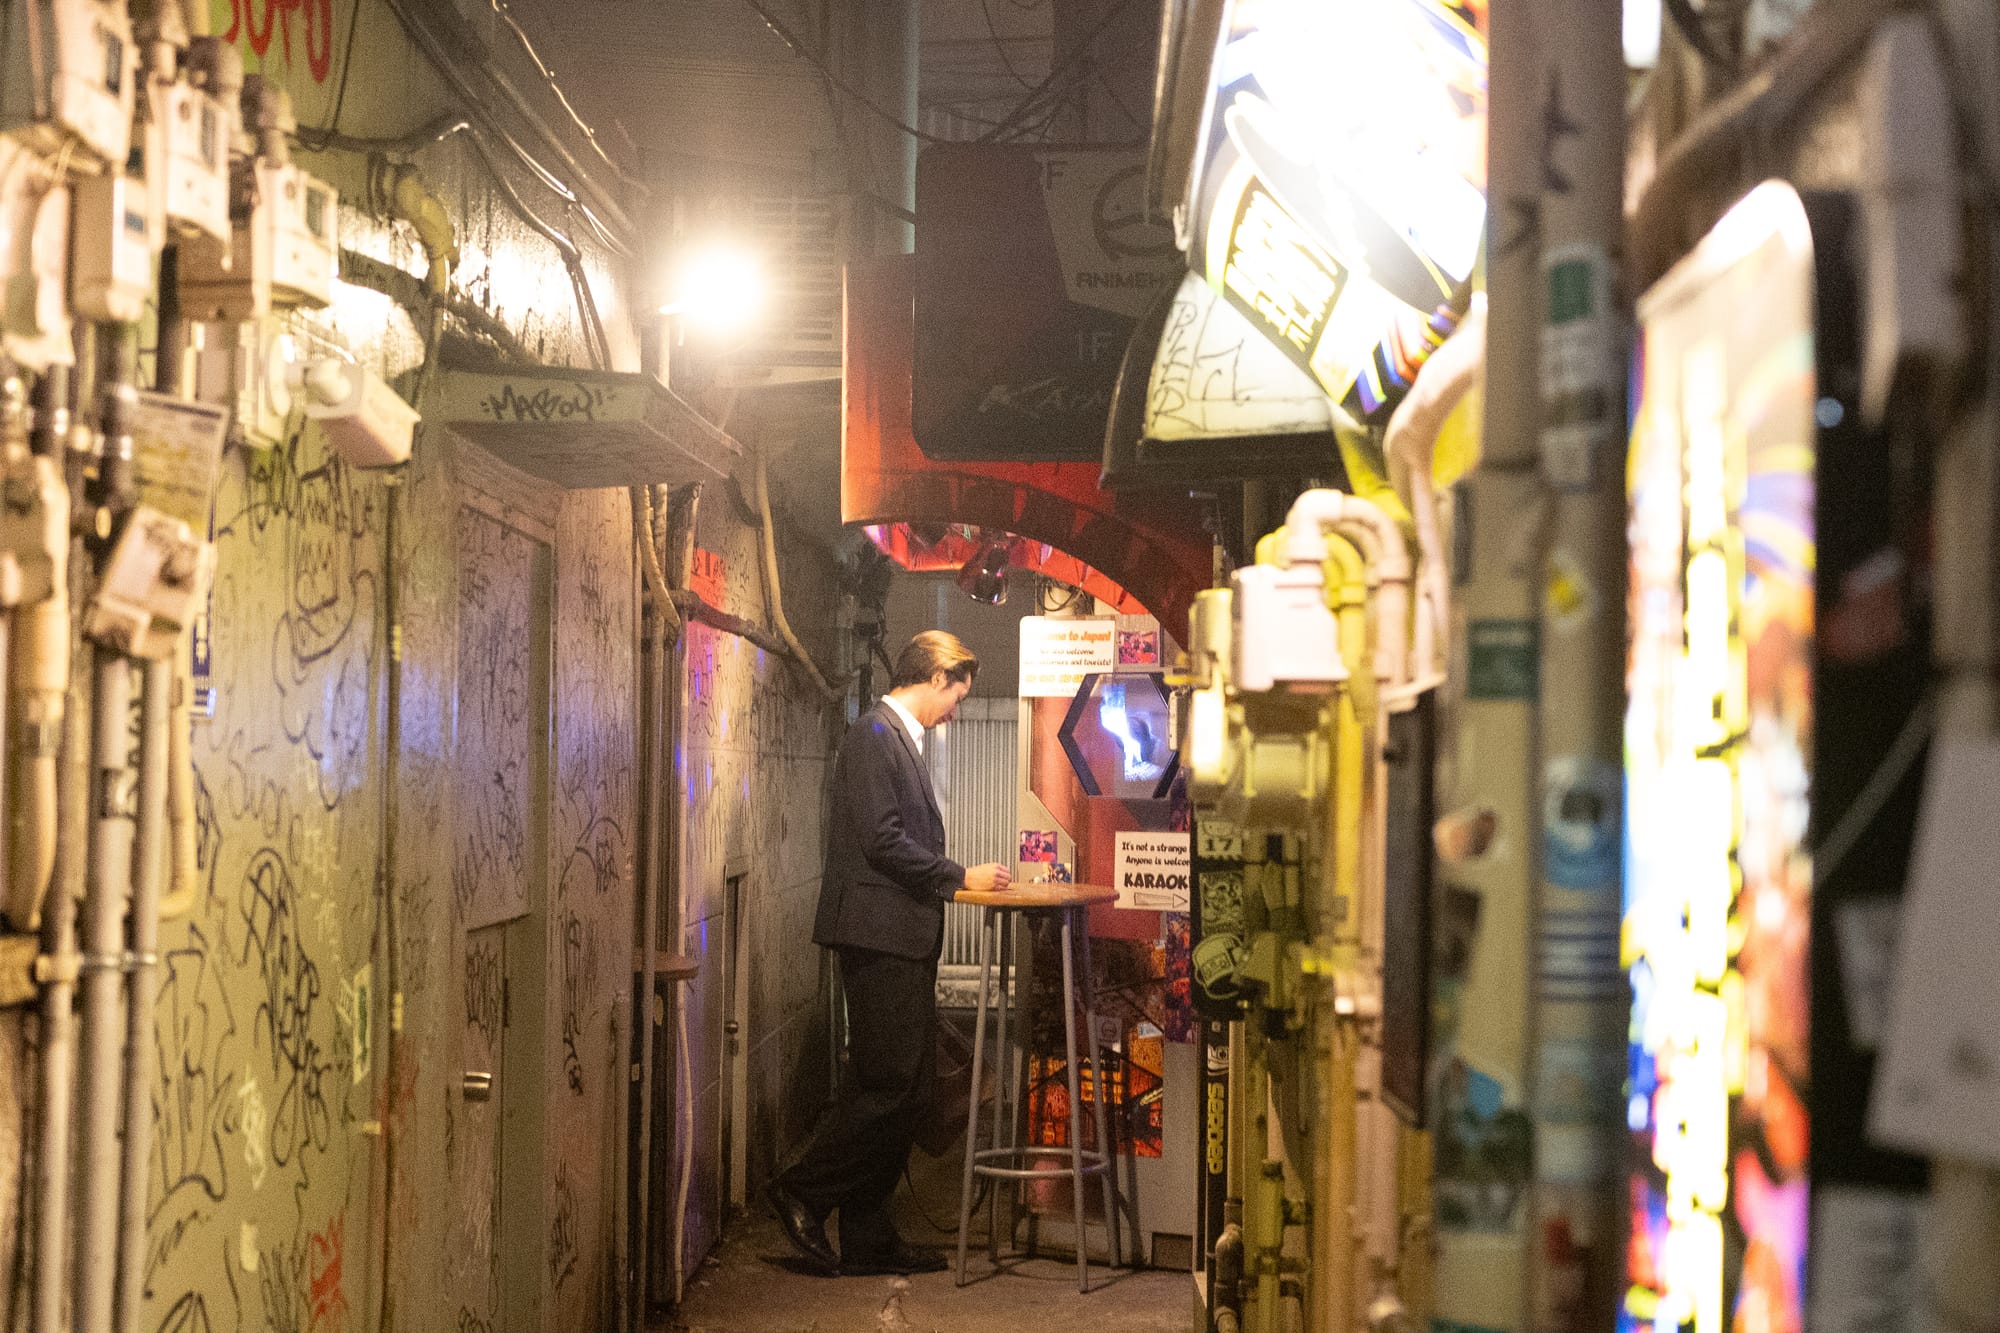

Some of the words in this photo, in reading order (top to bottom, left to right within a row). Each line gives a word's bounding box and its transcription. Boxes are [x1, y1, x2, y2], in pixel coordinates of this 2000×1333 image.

[1122, 842, 1134, 851] It's
[1136, 843, 1148, 851] not
[1157, 843, 1187, 854] strange
[1206, 838, 1233, 851] 17
[1126, 855, 1153, 866] Anyone
[1155, 856, 1162, 865] is
[1124, 872, 1190, 889] KARAOK
